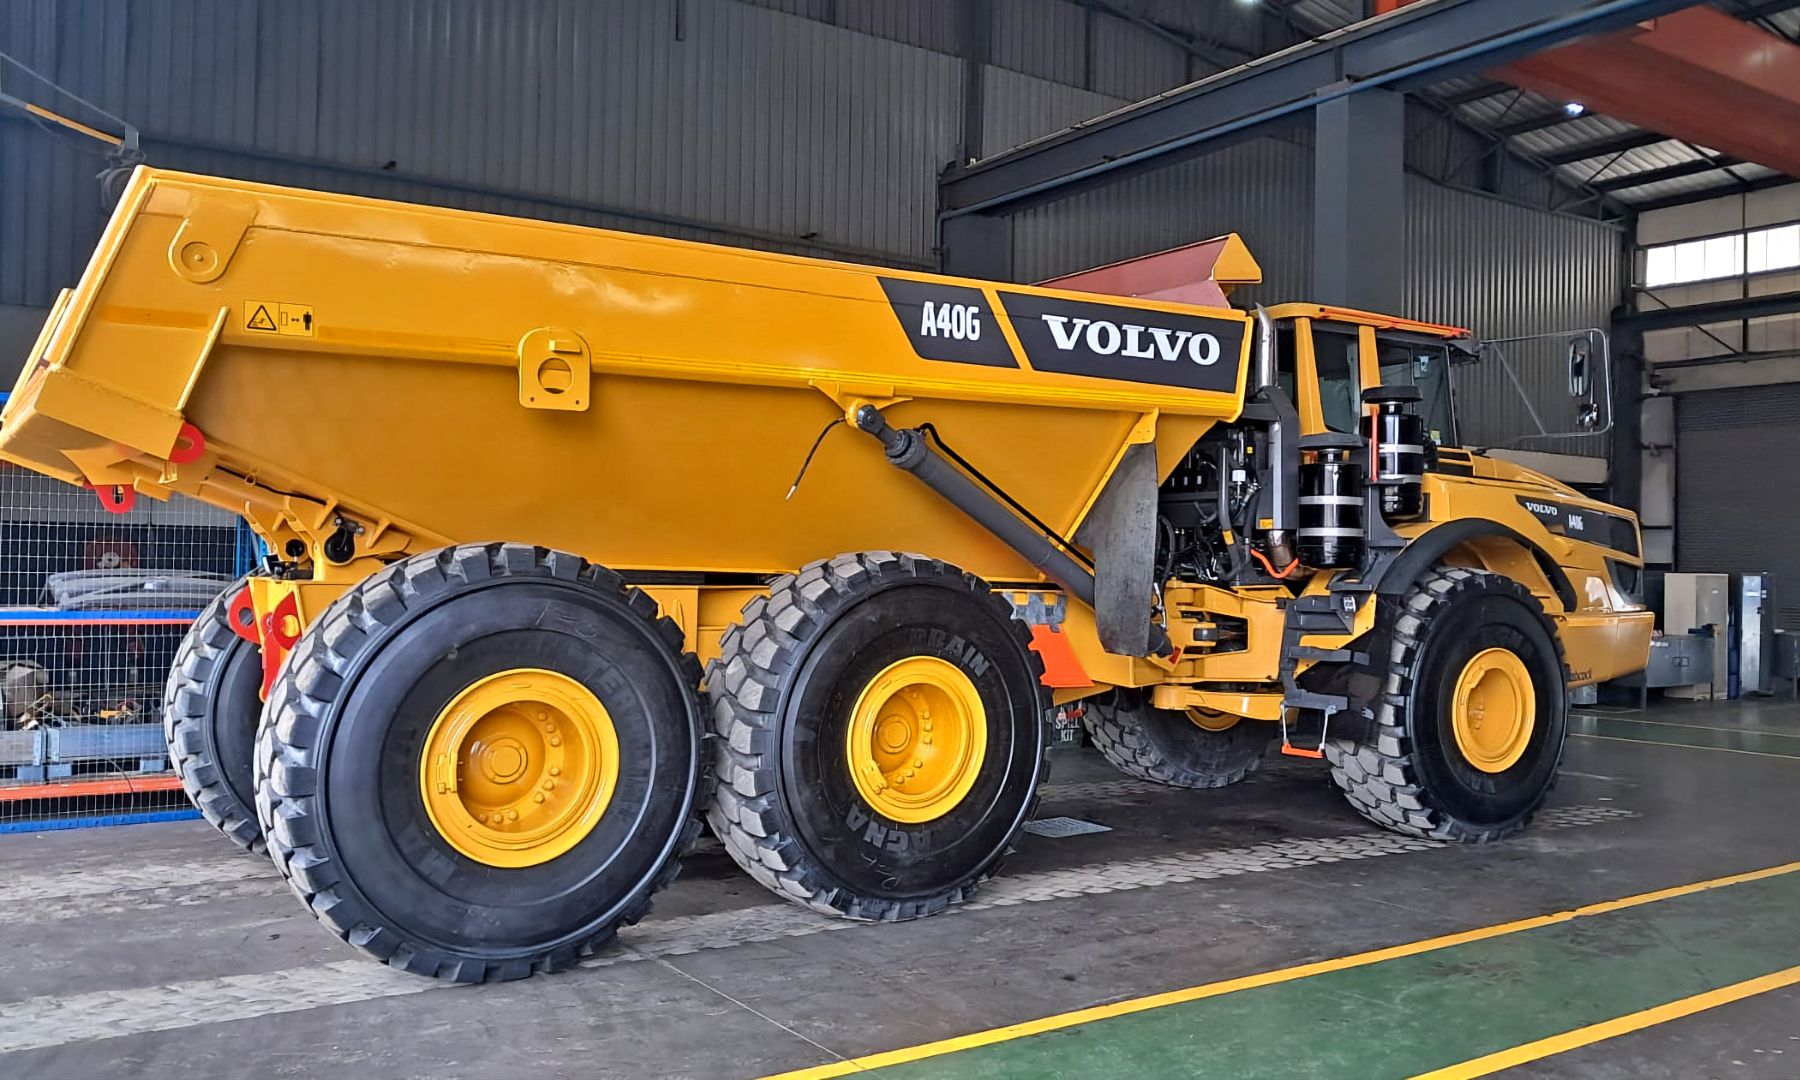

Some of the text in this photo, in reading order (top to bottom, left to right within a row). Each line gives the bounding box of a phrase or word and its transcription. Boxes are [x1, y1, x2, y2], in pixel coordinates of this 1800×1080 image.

[920, 300, 981, 342] A40G
[1041, 313, 1221, 366] VOLVO
[1525, 502, 1558, 516] VOLVO
[1060, 729, 1075, 743] KIT
